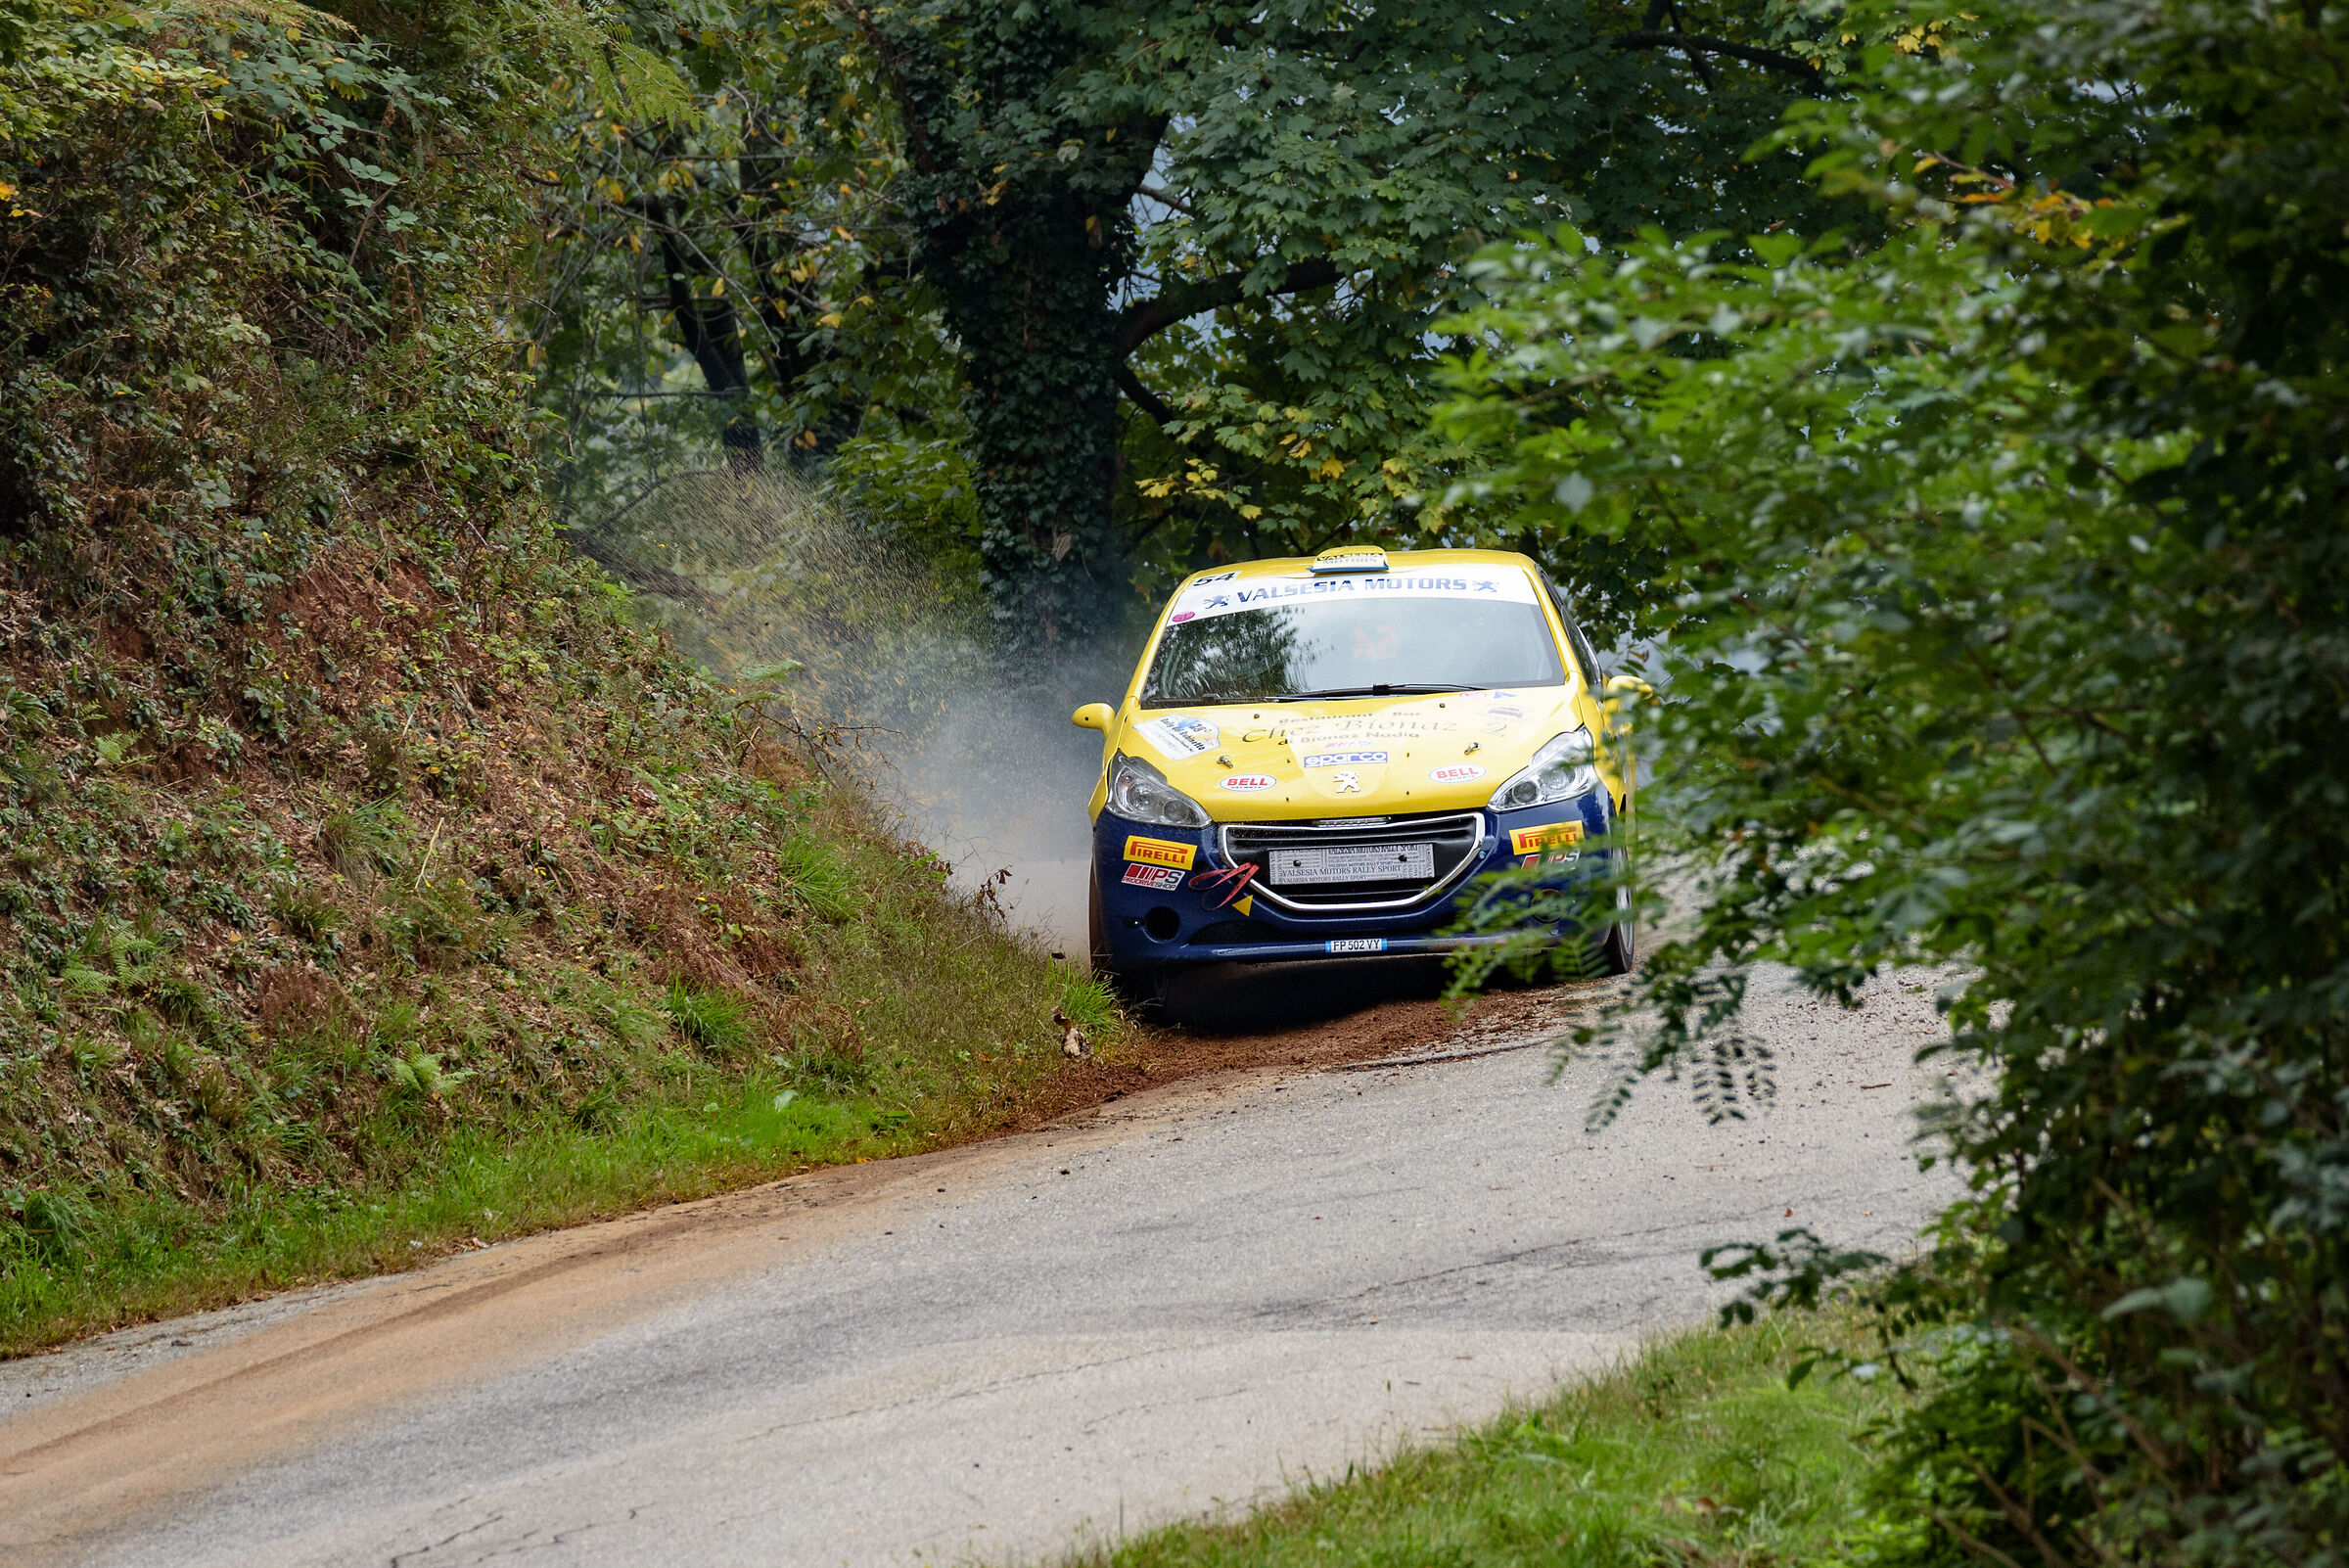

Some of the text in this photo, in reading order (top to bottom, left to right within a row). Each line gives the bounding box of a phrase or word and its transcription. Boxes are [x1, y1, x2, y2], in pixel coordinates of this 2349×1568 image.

[1193, 572, 1236, 586] 54
[1237, 577, 1467, 603] VALSESIA MOTORS
[1436, 767, 1479, 779] BELL
[1226, 777, 1268, 786] BELL
[1129, 841, 1188, 863] PIRELLI
[1282, 868, 1318, 877] VALSESIA
[1333, 941, 1347, 950] FP
[1348, 940, 1364, 950] 502
[1366, 939, 1380, 949] VY
